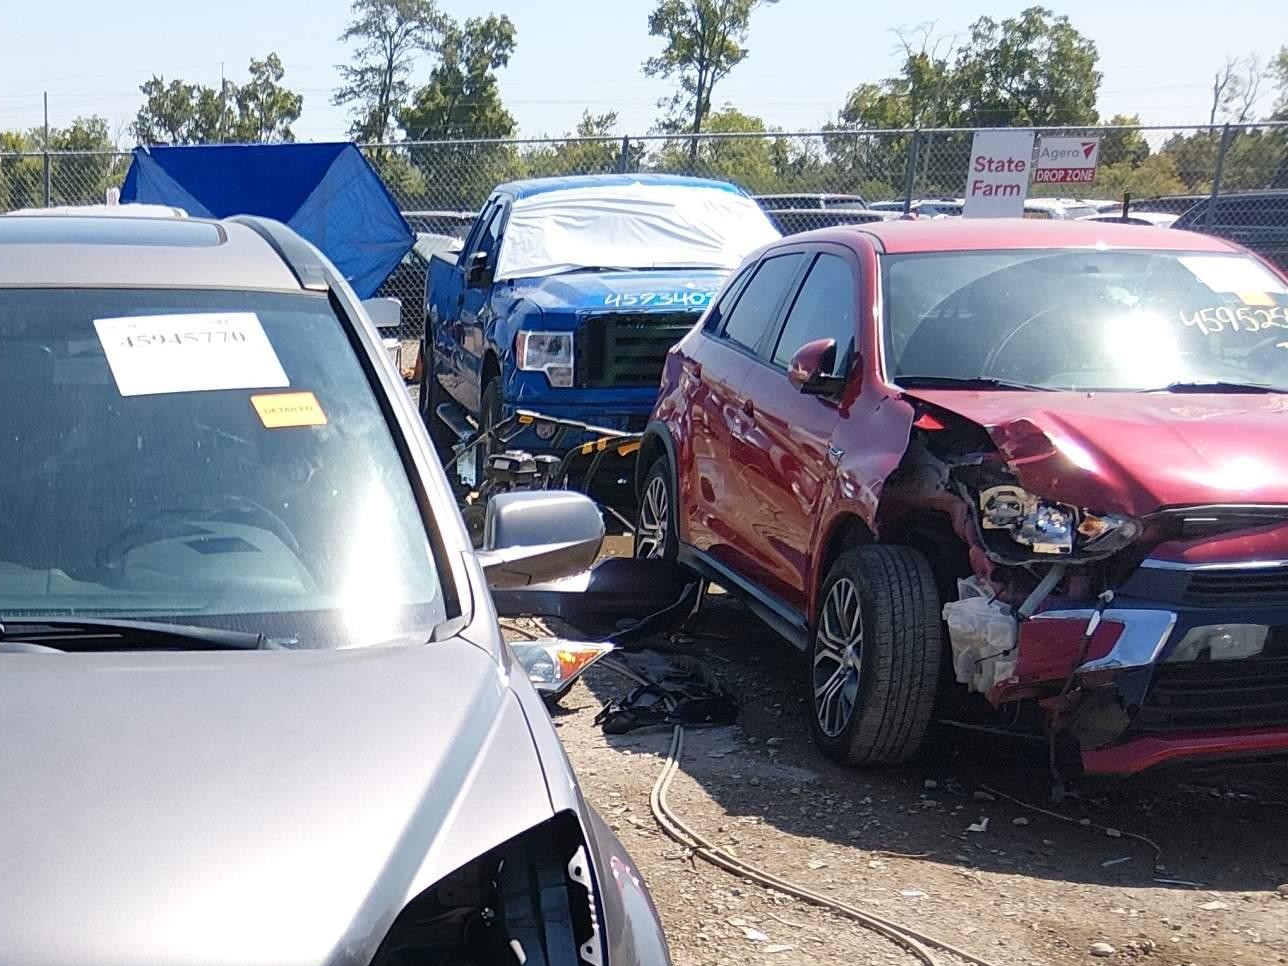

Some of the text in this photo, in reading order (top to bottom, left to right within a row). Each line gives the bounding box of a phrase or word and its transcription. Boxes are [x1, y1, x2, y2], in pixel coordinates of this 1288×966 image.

[1041, 146, 1080, 160] Agero
[973, 155, 1026, 173] State
[1036, 168, 1094, 182] DROP ZONE
[971, 180, 1021, 197] Farm
[1179, 306, 1288, 336] 459525
